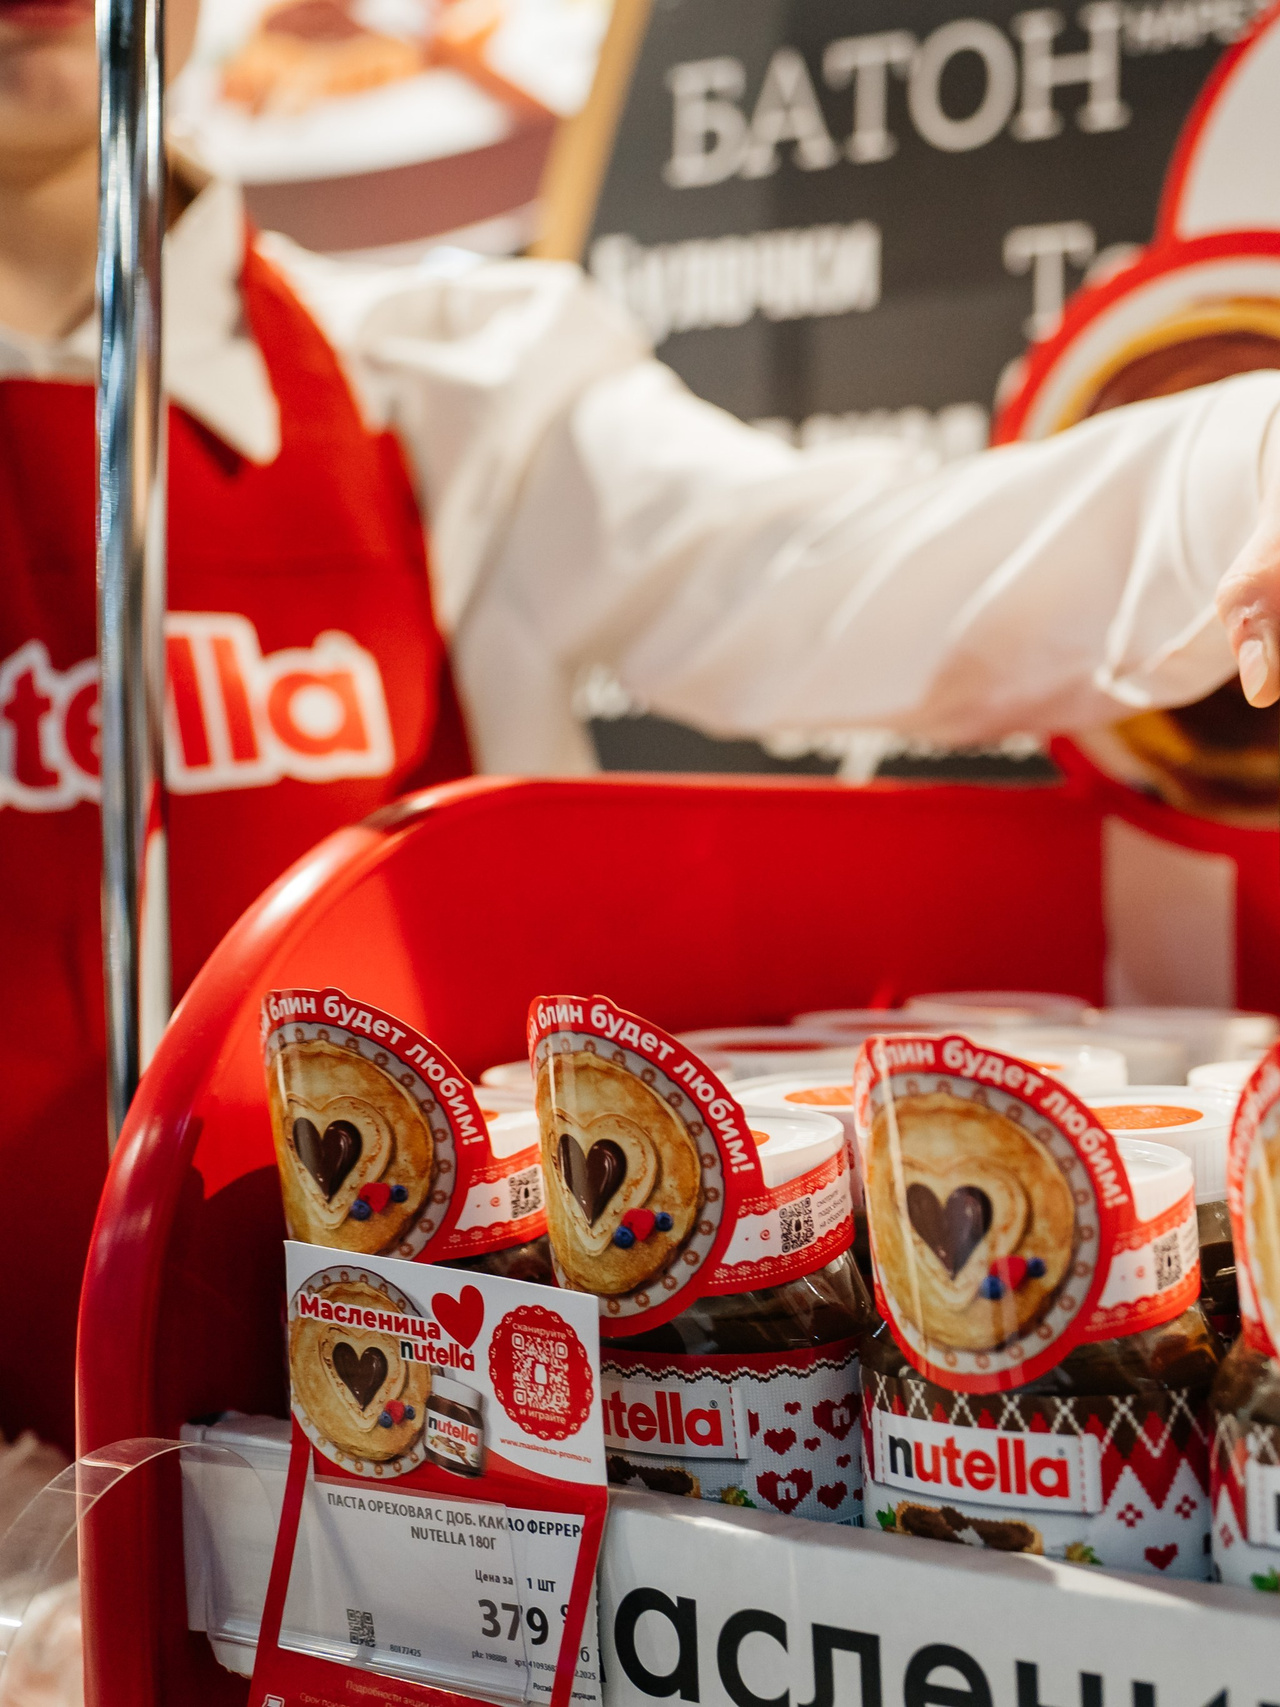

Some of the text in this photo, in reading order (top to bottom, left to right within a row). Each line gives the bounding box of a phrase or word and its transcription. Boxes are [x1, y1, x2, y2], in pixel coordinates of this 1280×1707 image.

[662, 3, 1131, 189] БАТОН
[2, 636, 371, 788] tella
[269, 997, 316, 1020] блин
[323, 996, 406, 1045] будет
[405, 1043, 484, 1146] любим!
[537, 1002, 584, 1029] блин
[590, 1003, 675, 1062] будет
[673, 1057, 756, 1174] любим!
[942, 1039, 1044, 1096] будет
[1040, 1089, 1128, 1209] любим!
[299, 1293, 441, 1341] Масленица
[512, 1322, 567, 1340] сканируйте
[400, 1340, 475, 1372] nutella
[428, 1413, 479, 1447] nutella
[528, 1410, 566, 1425] играйте
[602, 1390, 724, 1447] tella
[888, 1435, 1071, 1499] nutella
[327, 1492, 366, 1512] ПАСТА
[367, 1499, 433, 1521] ОРЕХОВАЯ
[435, 1509, 443, 1522] С
[446, 1510, 477, 1528] ДОБ.
[478, 1515, 525, 1533] КАКАО
[410, 1526, 466, 1546] NUTELLA
[475, 1569, 500, 1584] Цена
[502, 1575, 514, 1585] за
[478, 1599, 549, 1645] 379
[574, 1669, 597, 1680] 2.2025
